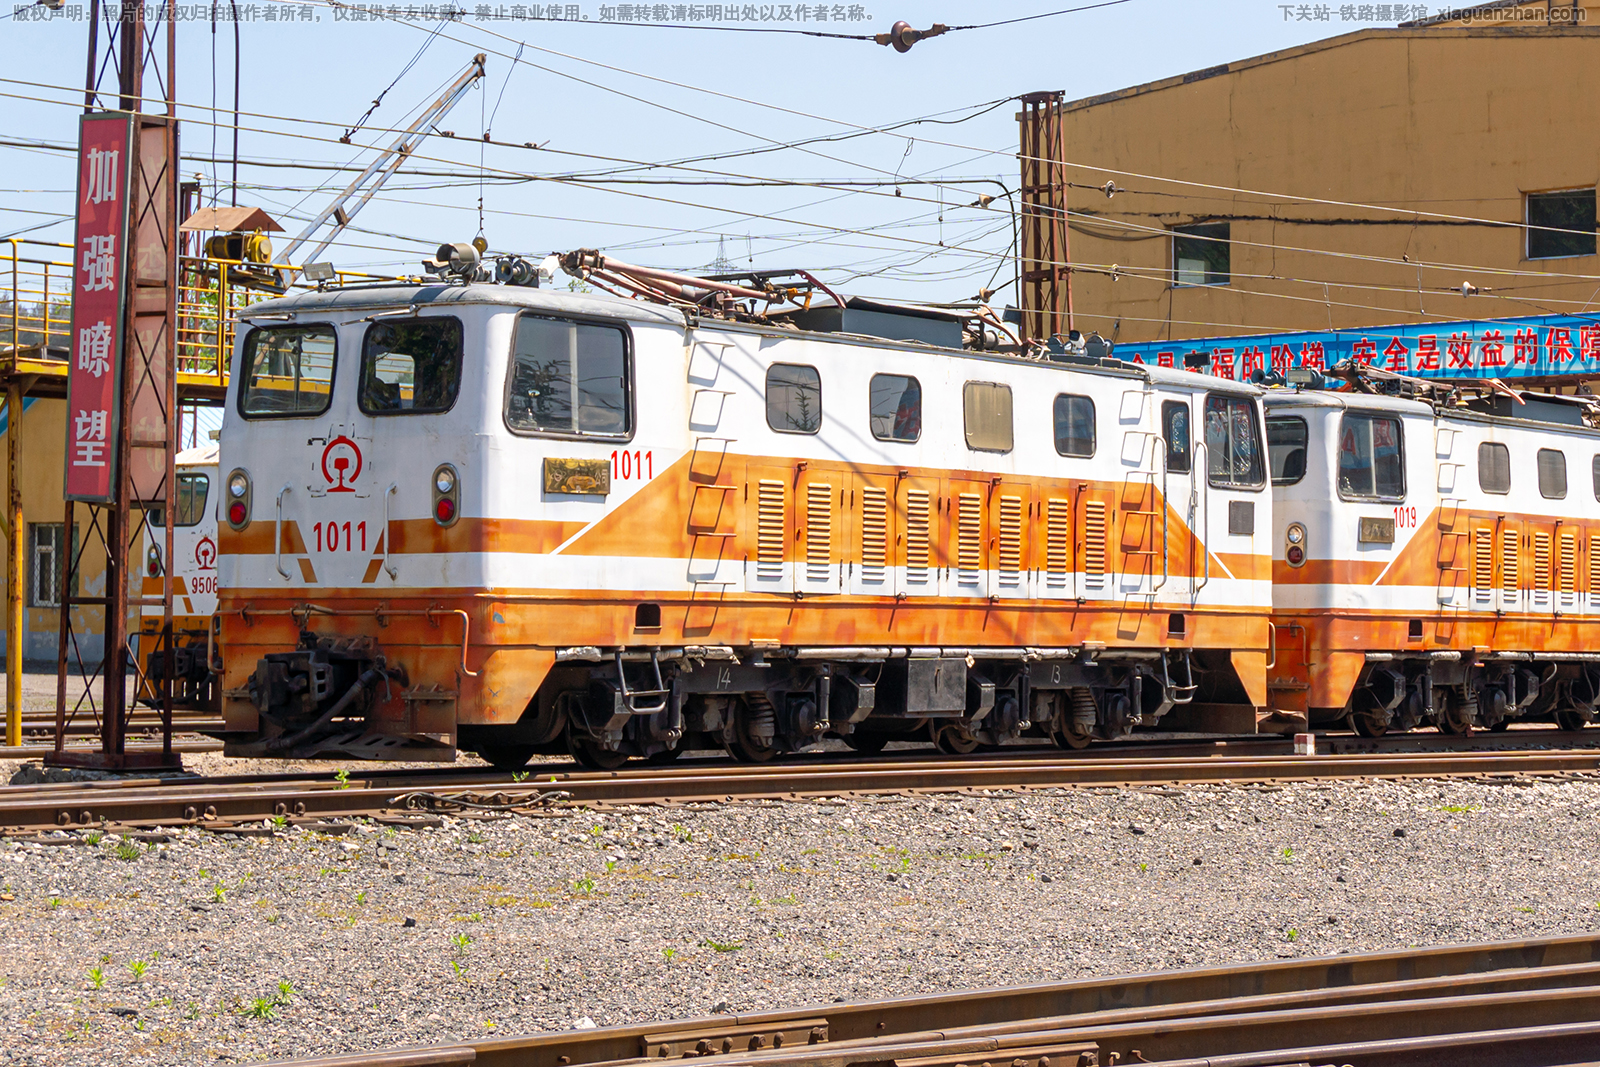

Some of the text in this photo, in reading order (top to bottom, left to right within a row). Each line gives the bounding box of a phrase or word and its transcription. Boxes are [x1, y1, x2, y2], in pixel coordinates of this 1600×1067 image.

[72, 148, 119, 467] 加强瞭望
[1352, 323, 1600, 372] 安全是效益的保障
[611, 450, 653, 480] 1011
[1393, 506, 1417, 528] 1019
[313, 520, 367, 552] 1011
[191, 576, 217, 594] 9506
[716, 666, 731, 690] 14
